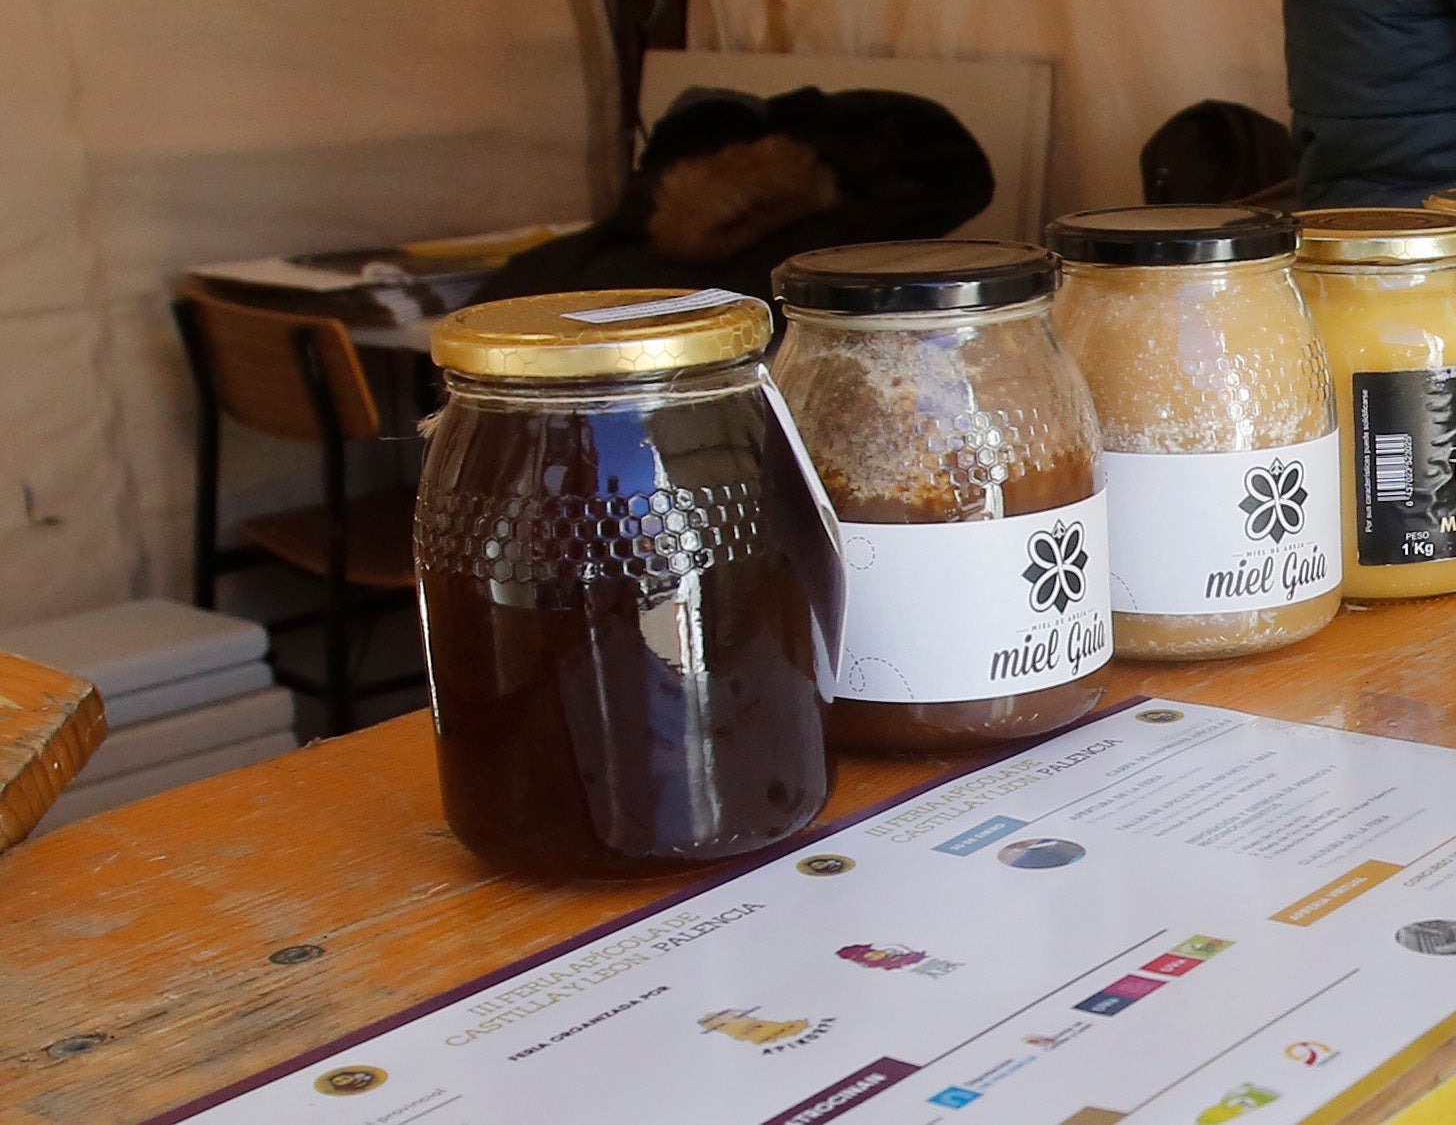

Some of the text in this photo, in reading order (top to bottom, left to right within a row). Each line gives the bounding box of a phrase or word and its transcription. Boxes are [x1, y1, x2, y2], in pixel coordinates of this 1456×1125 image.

[1362, 432, 1372, 454] puede
[1365, 520, 1373, 533] Por
[1402, 542, 1434, 556] 1 Kg
[1405, 531, 1430, 540] PESO
[1206, 544, 1328, 602] miel Gaia
[990, 614, 1107, 682] miel Gaia
[885, 801, 945, 828] FERIA
[1019, 757, 1044, 774] DE
[890, 798, 983, 844] CASTILLA
[1036, 737, 1125, 776] PALENCIA
[467, 912, 702, 1018] III FERIA APÍCOLA DE
[446, 985, 573, 1048] CASTILLA
[563, 980, 592, 993] Y
[508, 984, 672, 1062] FERIA ORGANIZADA POR
